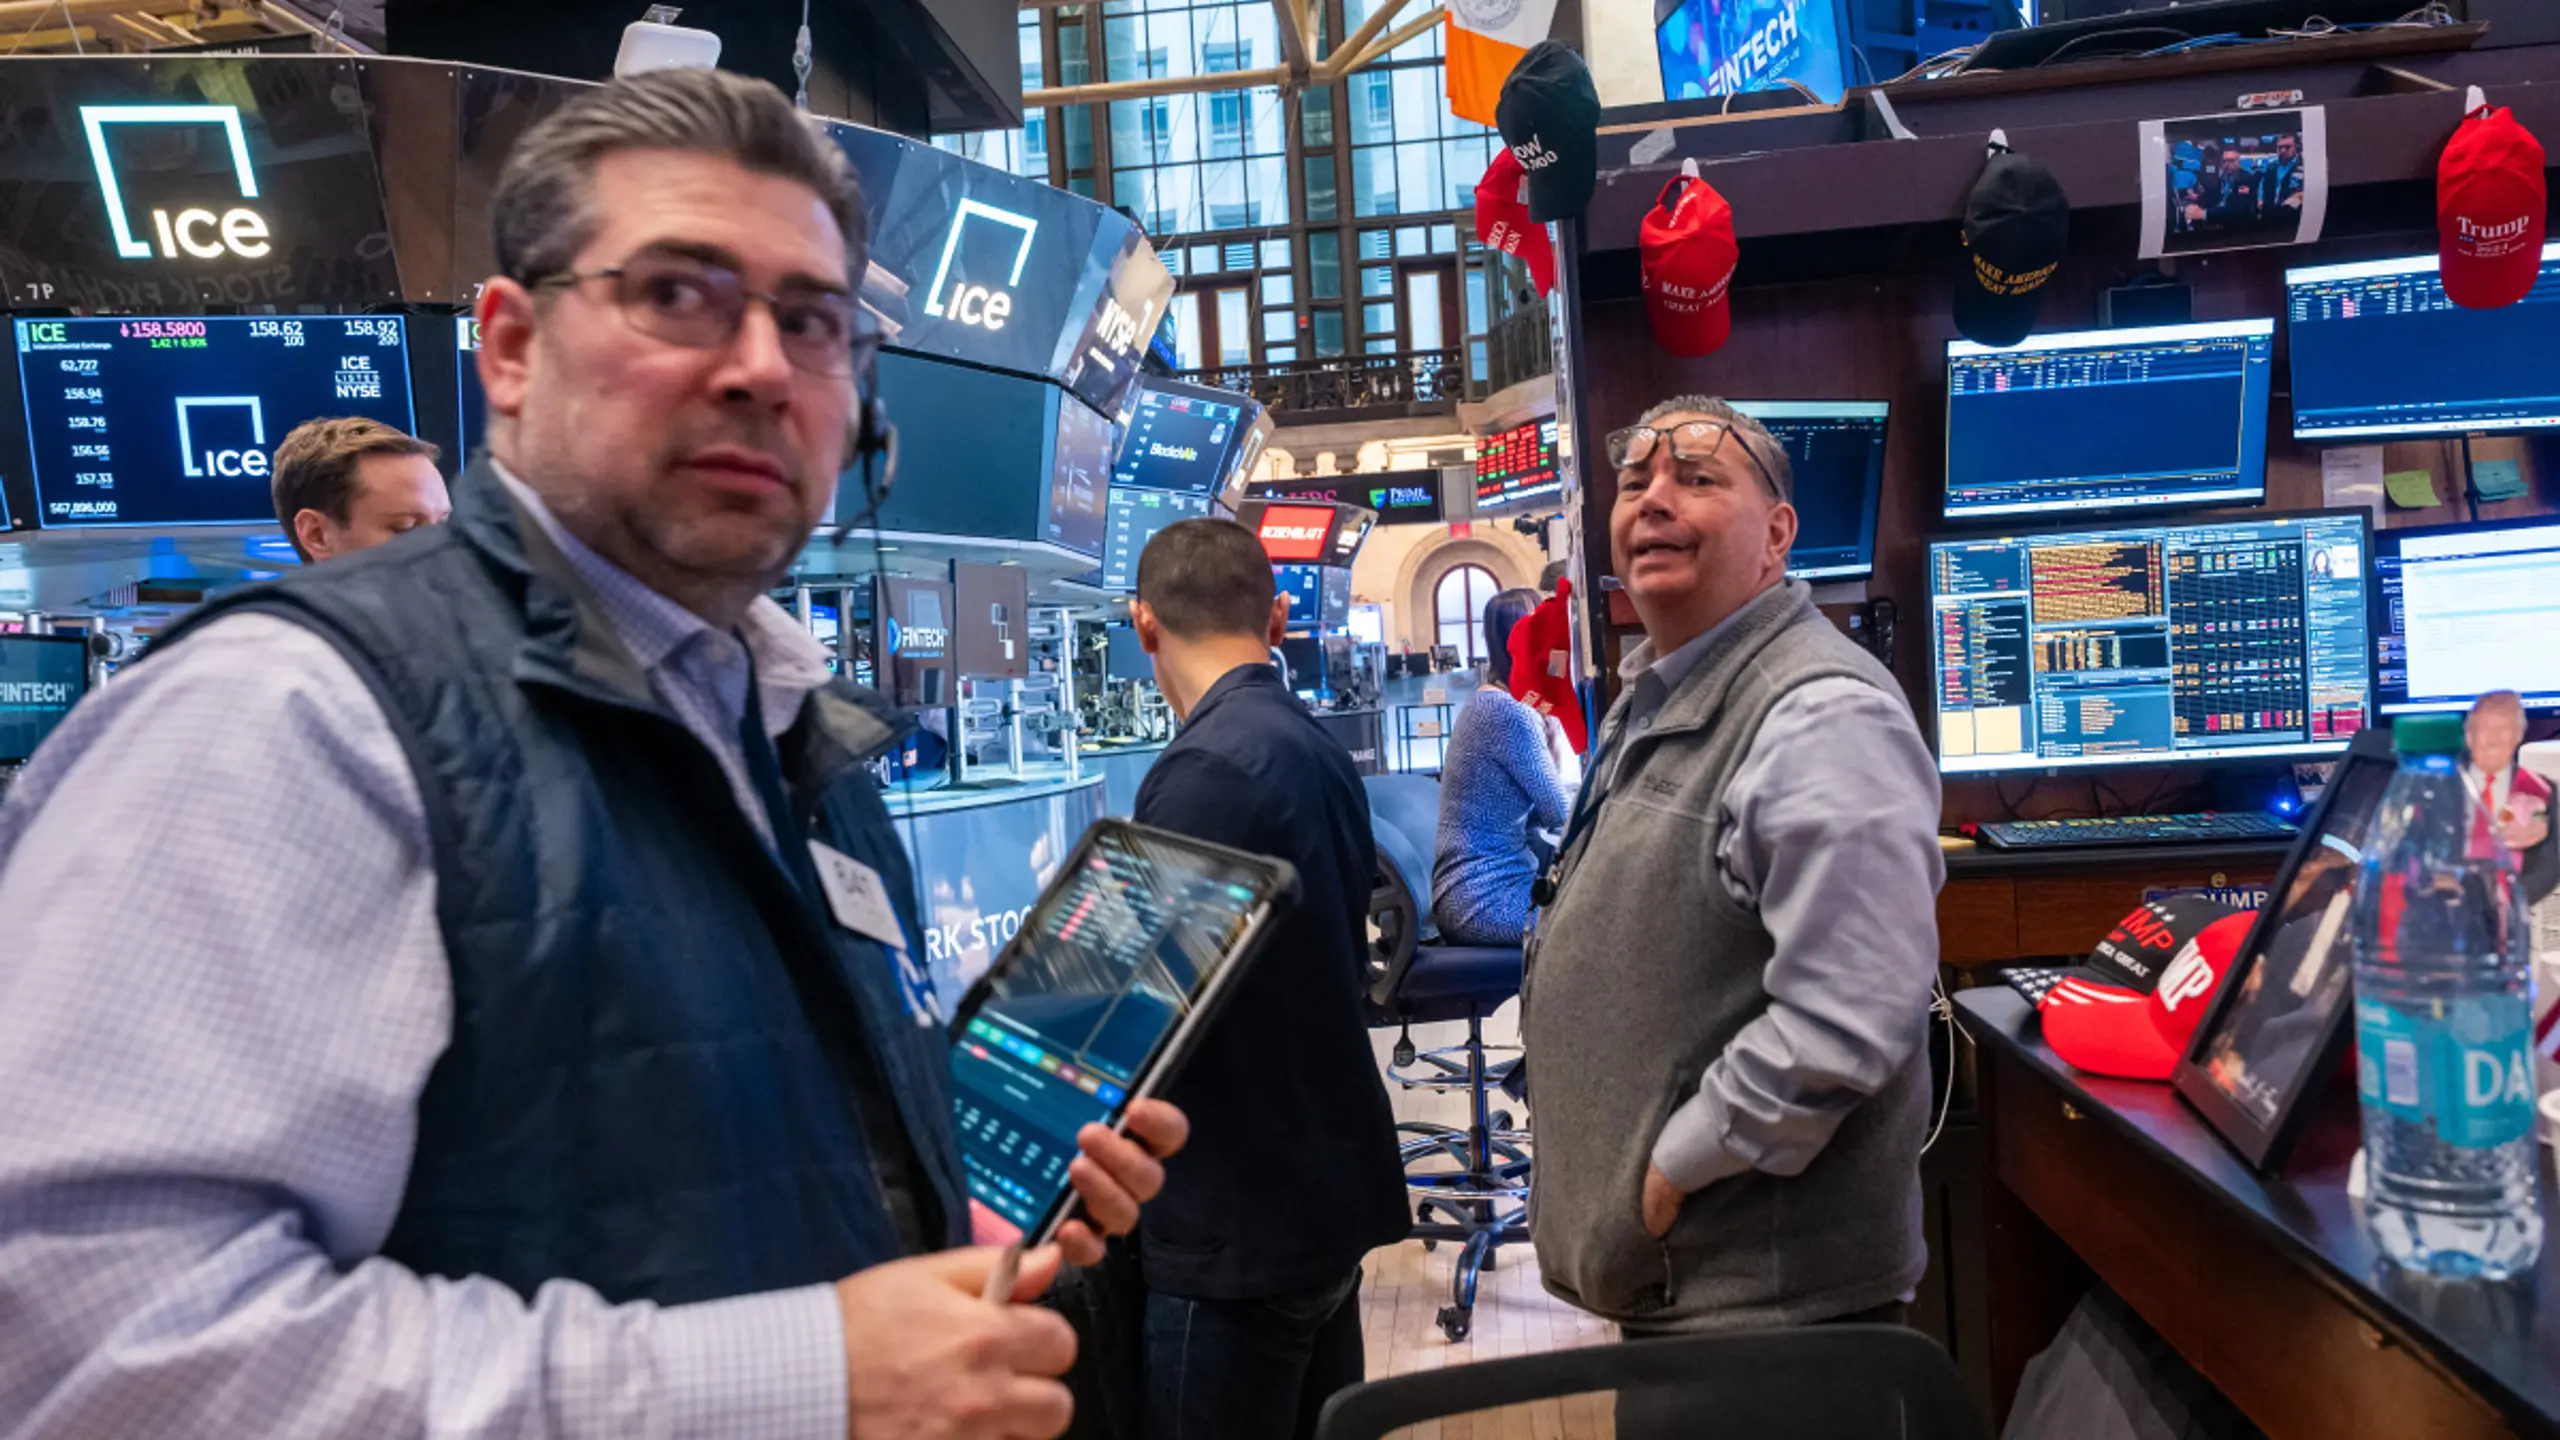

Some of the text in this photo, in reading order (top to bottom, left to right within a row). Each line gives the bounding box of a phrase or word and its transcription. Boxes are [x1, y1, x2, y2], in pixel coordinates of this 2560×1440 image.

[1708, 1, 1798, 97] FINTECH
[2456, 213, 2530, 239] Trump
[1661, 280, 1696, 300] MAKE
[1663, 299, 1701, 313] GREAT
[31, 320, 398, 342] ICE 158.5800 158.62 158.92
[283, 335, 399, 347] 100 200
[341, 356, 371, 370] ICE
[336, 385, 382, 398] NYSE
[902, 626, 945, 649] FINTECH
